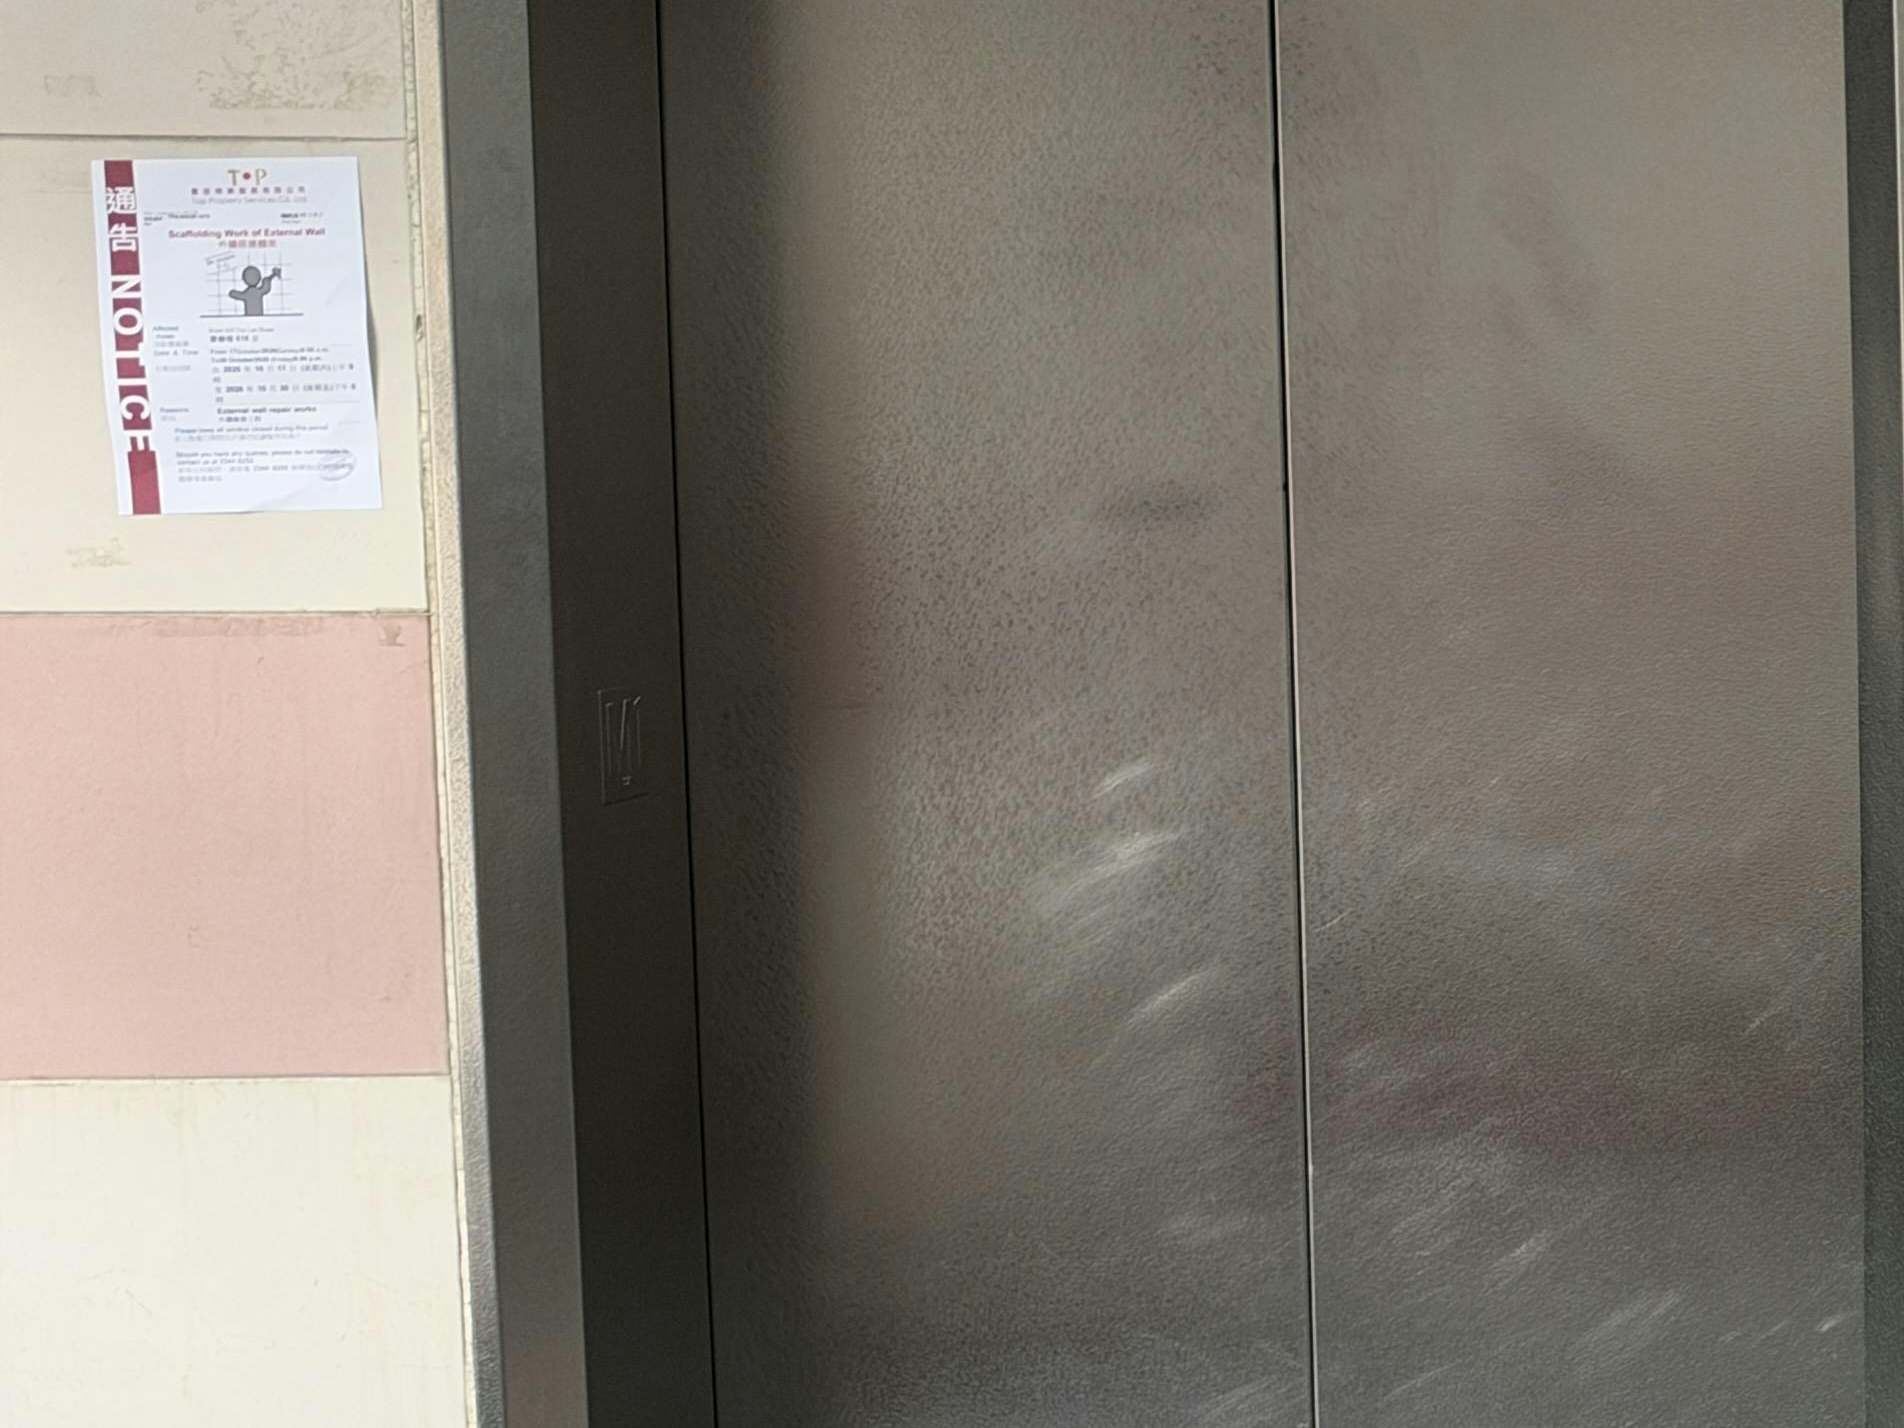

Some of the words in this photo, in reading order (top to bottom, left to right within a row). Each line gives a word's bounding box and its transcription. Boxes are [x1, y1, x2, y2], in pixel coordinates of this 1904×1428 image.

[105, 186, 138, 253] 通告
[168, 229, 222, 240] Scaffolding
[224, 229, 248, 237] Work
[264, 228, 302, 236] External
[112, 275, 151, 452] NOTICE
